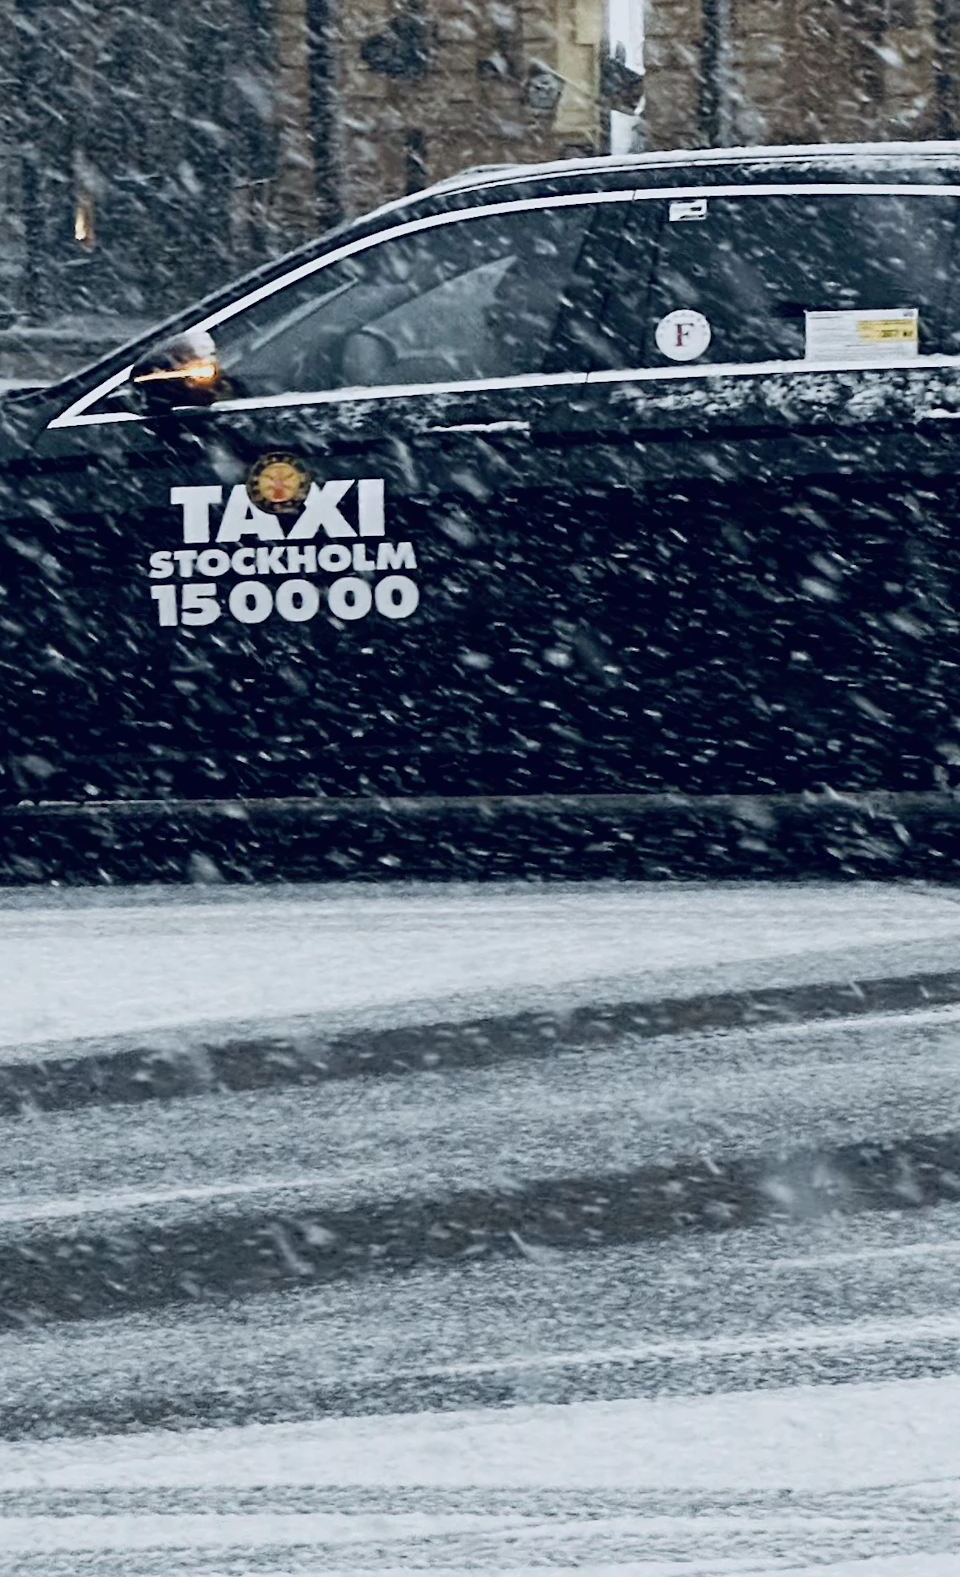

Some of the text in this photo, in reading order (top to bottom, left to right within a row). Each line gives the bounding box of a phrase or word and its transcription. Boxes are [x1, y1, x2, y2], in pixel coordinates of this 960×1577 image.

[674, 322, 695, 347] F
[170, 478, 386, 544] TAXI
[149, 542, 418, 579] STOCKHOLM
